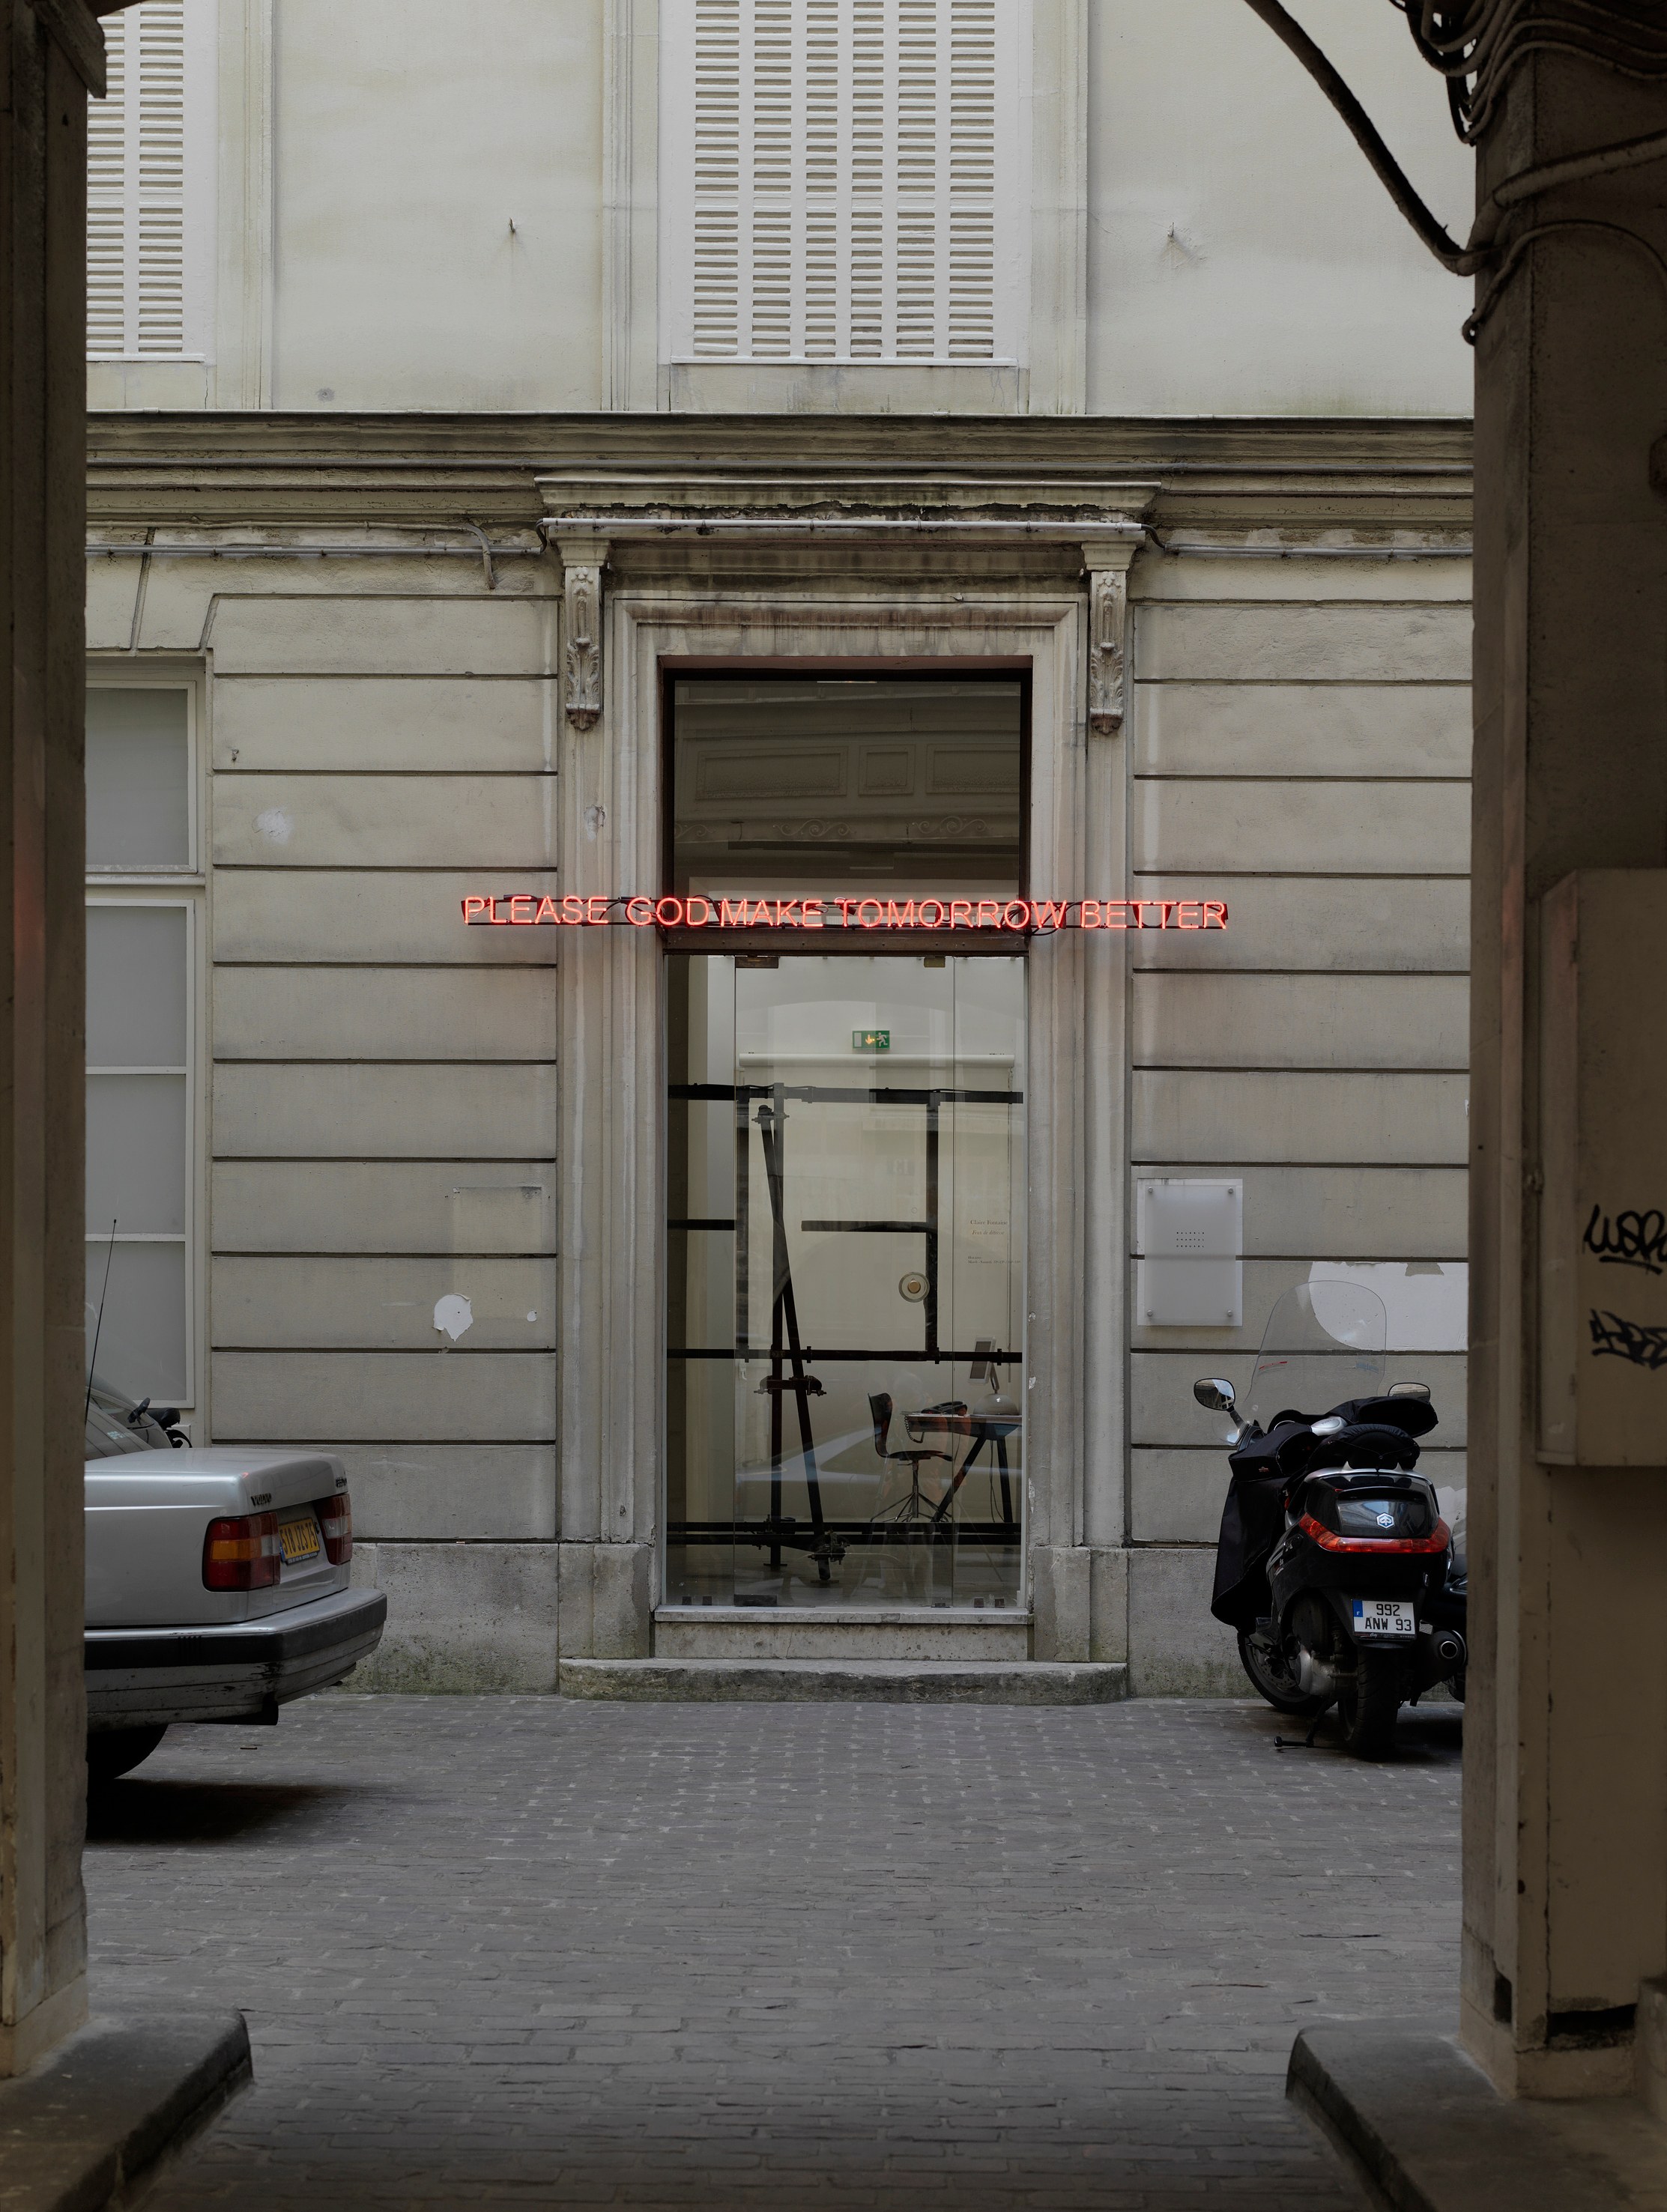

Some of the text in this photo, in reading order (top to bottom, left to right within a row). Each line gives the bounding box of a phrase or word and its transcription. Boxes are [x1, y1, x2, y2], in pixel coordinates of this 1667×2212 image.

[464, 895, 1227, 930] PLEASE GOD MAKE TOMORROW BETTER
[1376, 1603, 1400, 1616] 992
[1365, 1617, 1412, 1631] ANW 93
